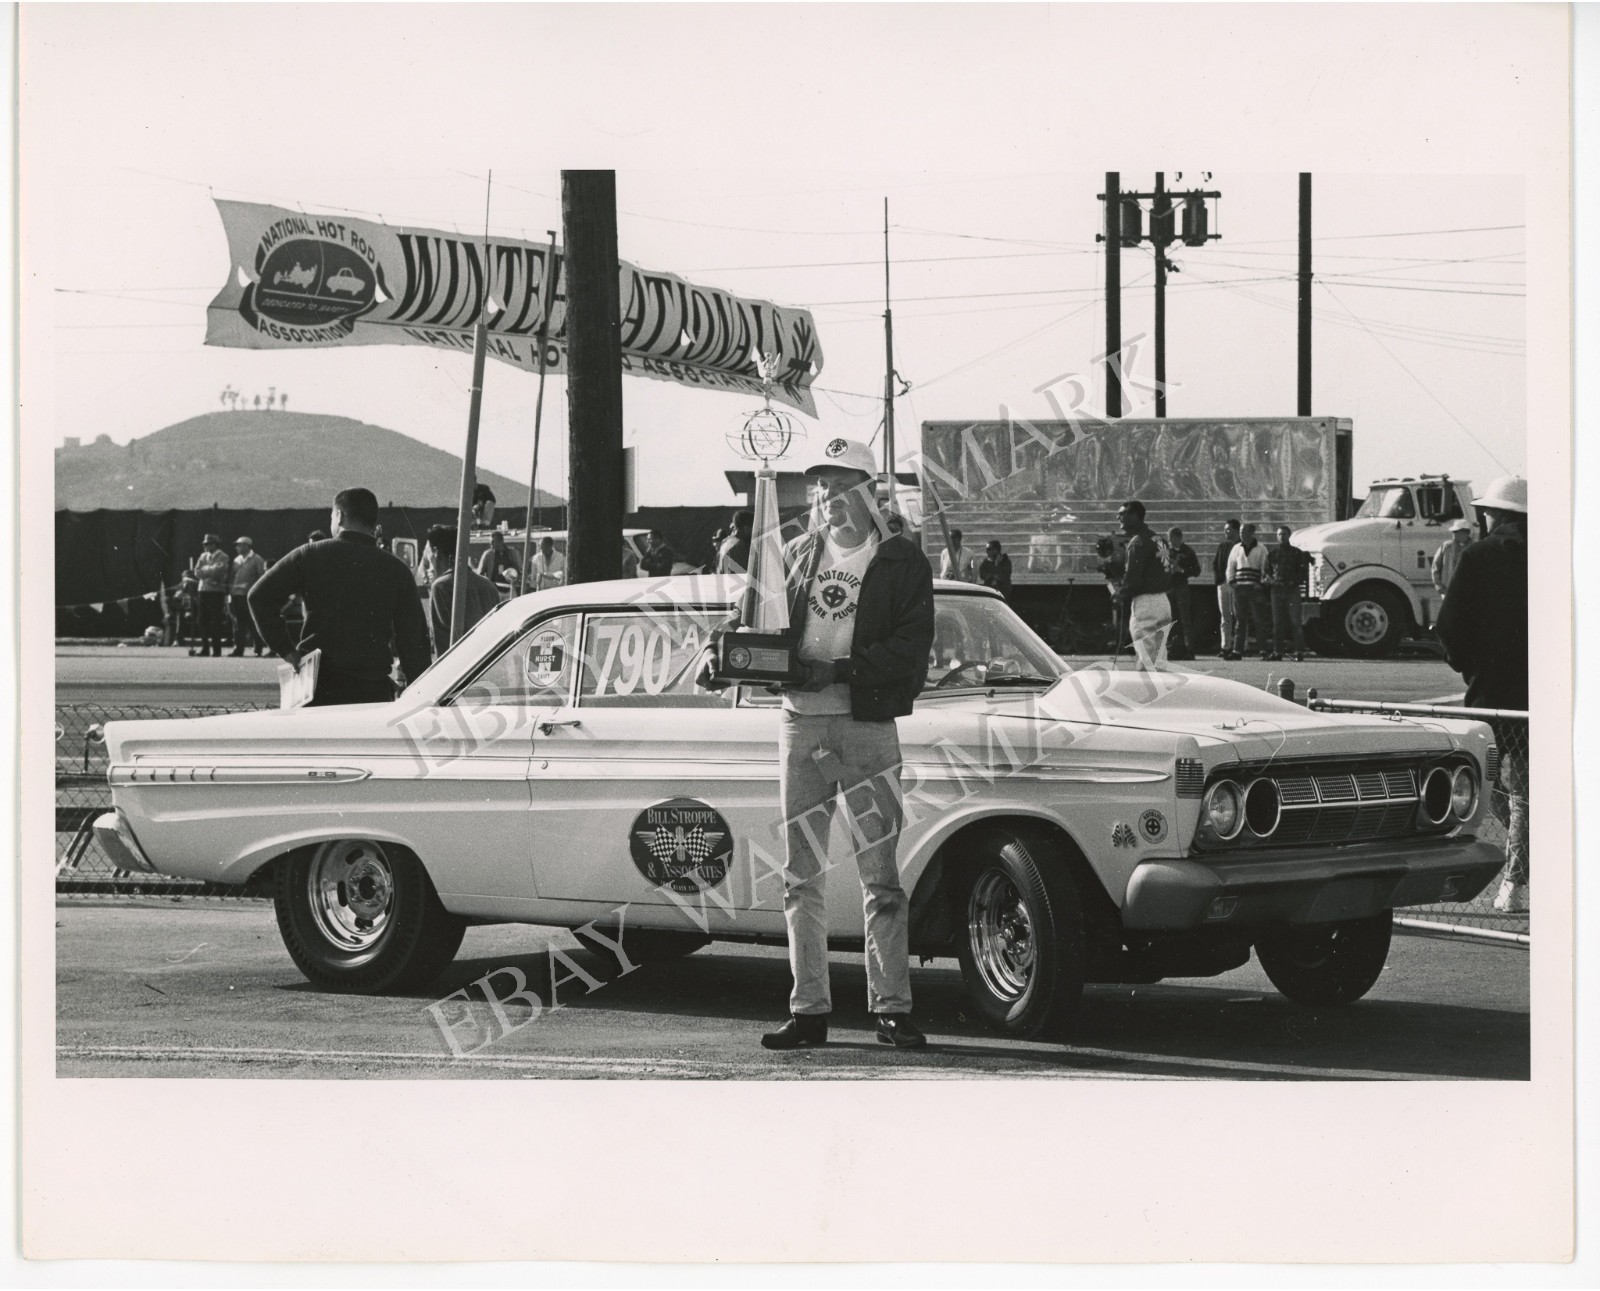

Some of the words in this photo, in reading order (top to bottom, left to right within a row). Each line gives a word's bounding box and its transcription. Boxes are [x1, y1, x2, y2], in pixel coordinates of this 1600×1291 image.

[261, 217, 314, 252] NATIONAL
[316, 220, 345, 242] HOT
[350, 229, 375, 265] ROD
[387, 233, 786, 380] WINTERATIONALS
[816, 570, 861, 589] AUTOLITE
[807, 595, 828, 619] SPARK
[832, 602, 857, 621] PLUGS
[535, 655, 557, 663] HURST
[595, 623, 671, 696] 790
[647, 808, 670, 824] BILL
[670, 807, 717, 824] STROPPE
[647, 861, 656, 878] &
